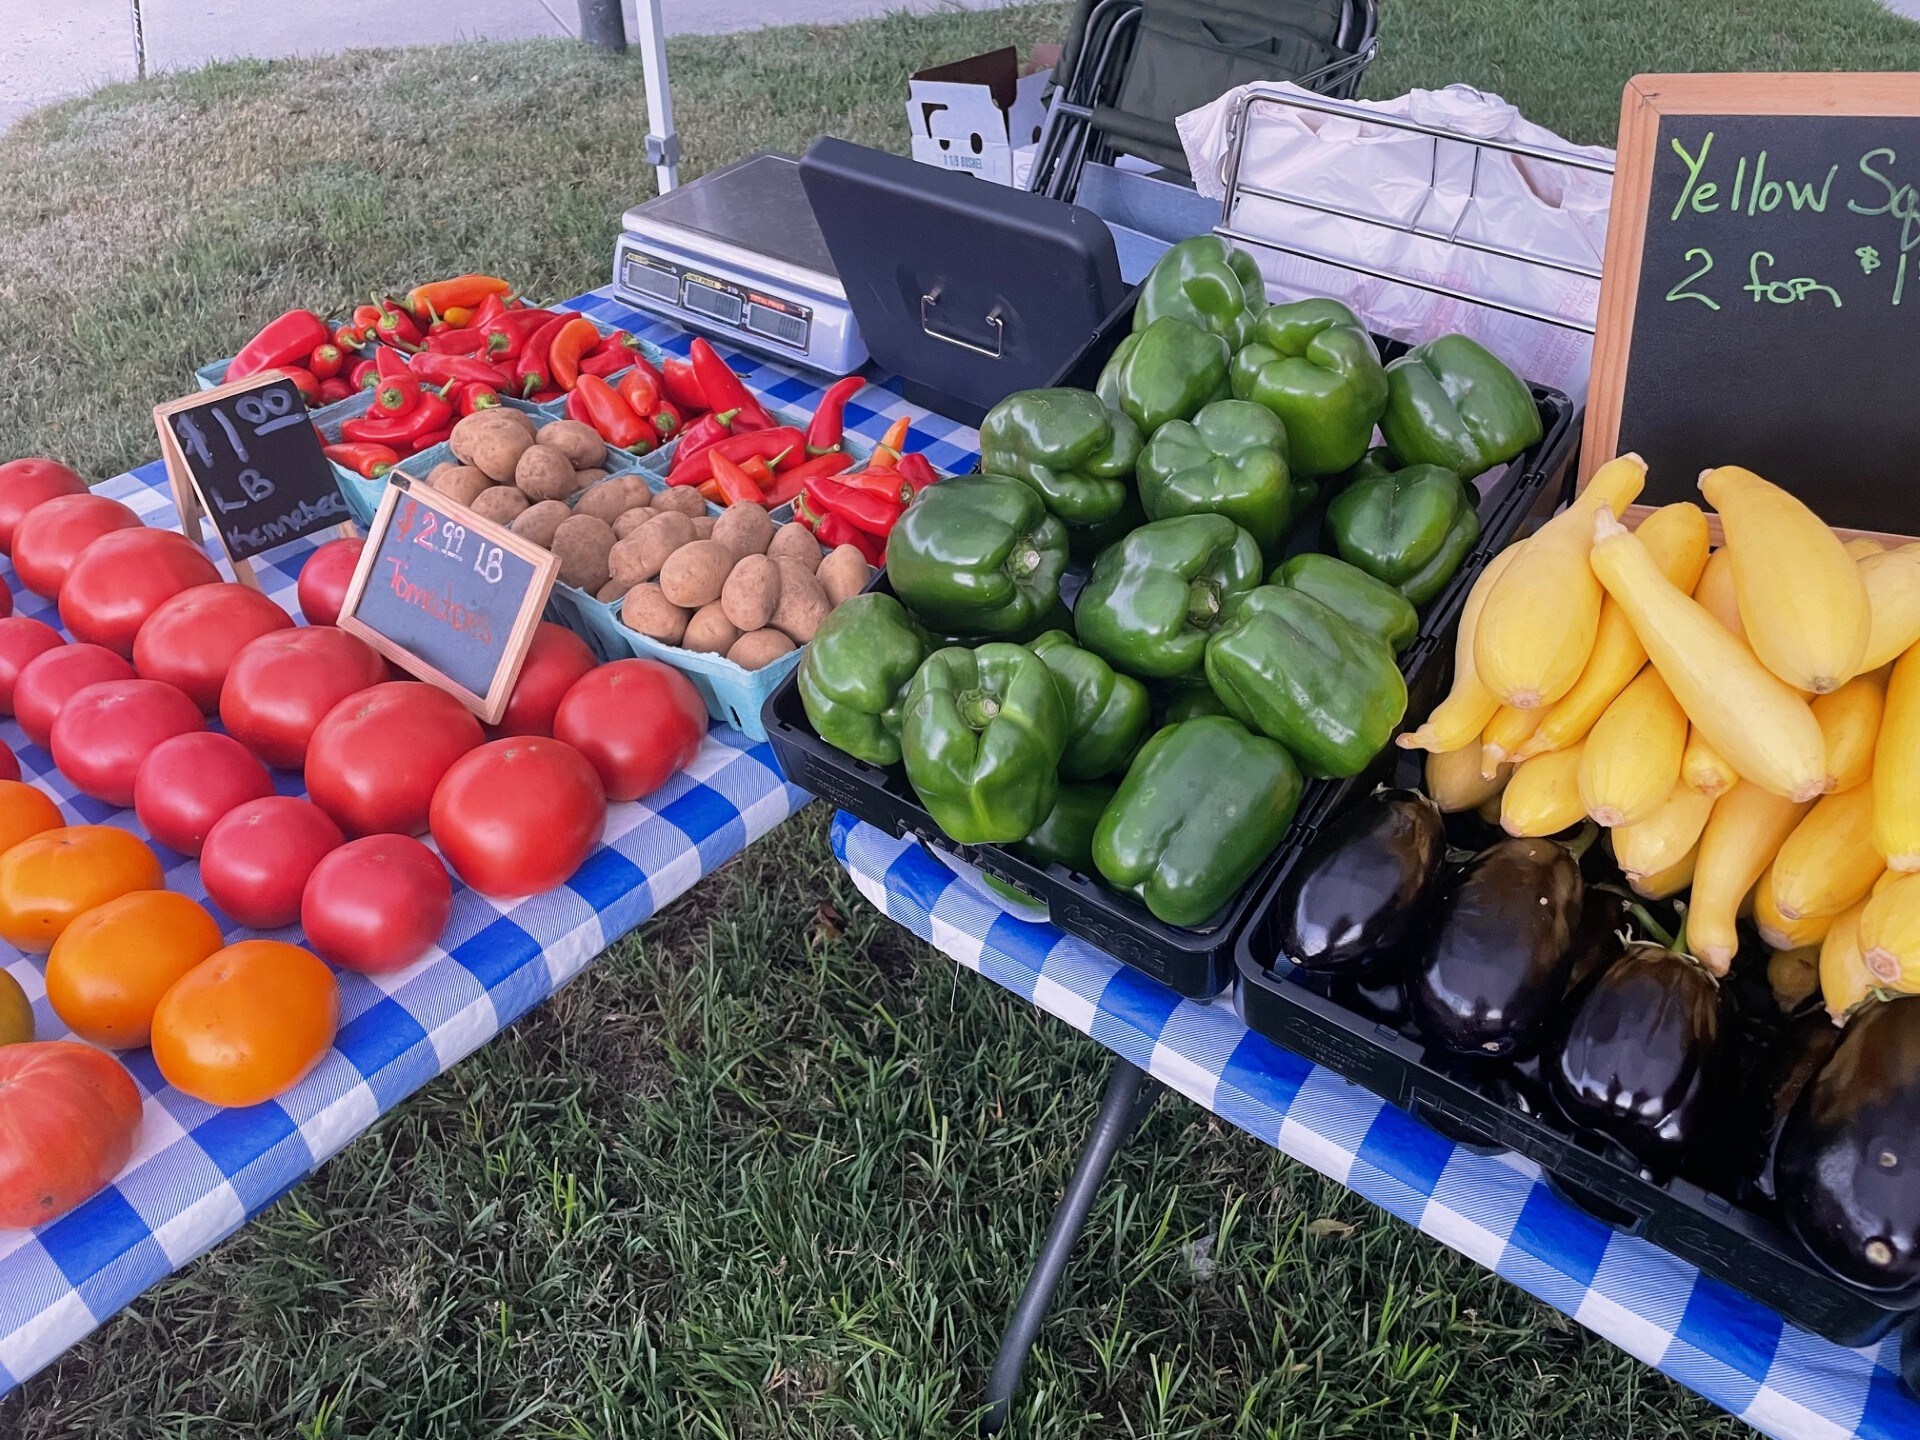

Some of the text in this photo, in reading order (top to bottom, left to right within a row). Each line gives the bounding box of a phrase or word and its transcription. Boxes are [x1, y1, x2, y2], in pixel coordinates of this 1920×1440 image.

[1671, 131, 1920, 251] Yellow Sq
[701, 277, 716, 287] PRICE
[1666, 248, 1721, 310] 2
[1855, 246, 1920, 305] $1
[210, 468, 275, 515] LB
[473, 542, 504, 584] LB
[386, 555, 494, 647] Tomatoes
